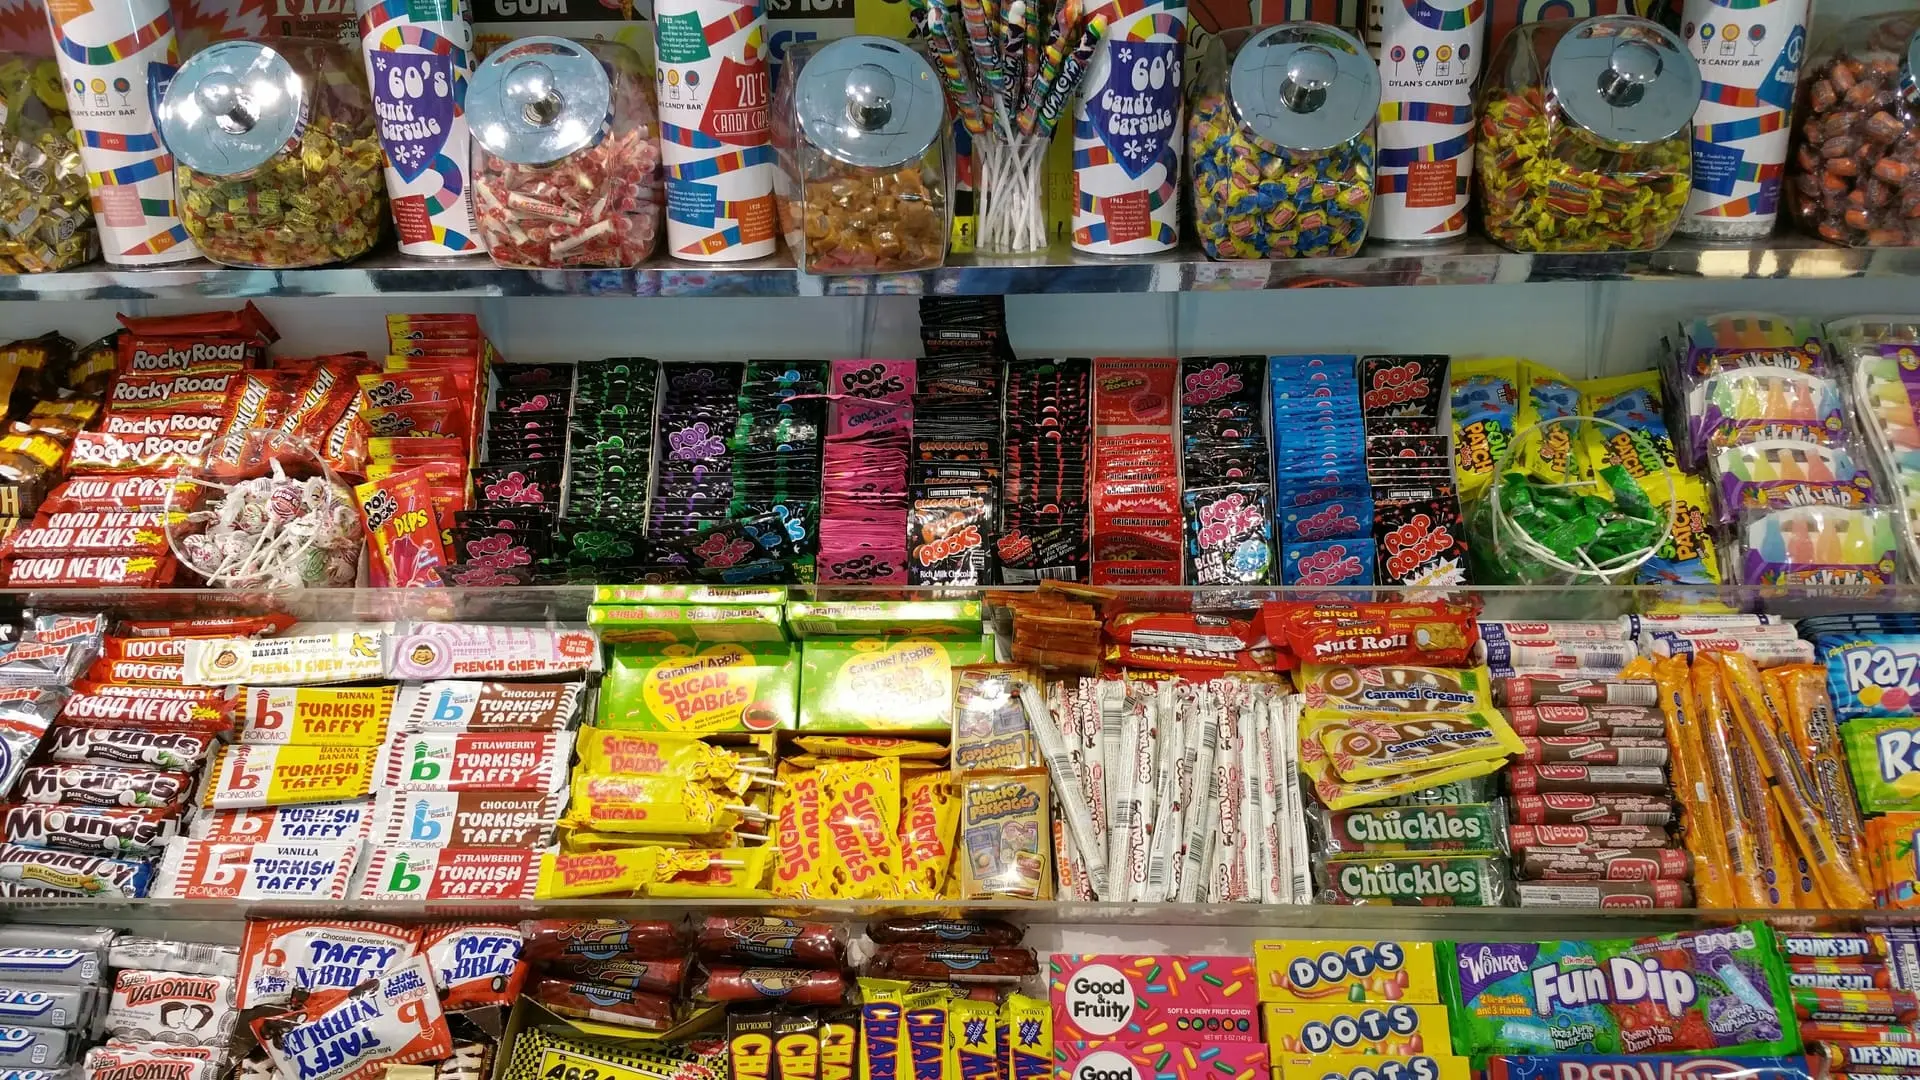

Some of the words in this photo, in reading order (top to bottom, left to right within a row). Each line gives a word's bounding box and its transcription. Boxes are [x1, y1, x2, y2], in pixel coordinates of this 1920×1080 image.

[1132, 50, 1180, 91] 60's
[389, 64, 448, 98] 60's
[374, 98, 413, 122] Candy
[1101, 88, 1153, 115] Candy
[90, 108, 118, 117] CANDY
[713, 111, 748, 132] CANDY
[1108, 108, 1172, 135] Capsule
[381, 118, 441, 141] Capsule
[133, 349, 191, 370] Rocky
[192, 342, 246, 361] Road
[842, 364, 886, 389] POP
[1185, 362, 1230, 392] POP
[1374, 362, 1422, 390] POP
[112, 378, 174, 400] Rocky
[174, 375, 229, 394] Road
[1365, 378, 1429, 410] ROCKS
[108, 414, 168, 435] Rocky
[74, 438, 142, 460] Rocky
[146, 436, 205, 457] Road
[1464, 421, 1494, 474] PATCH
[1611, 433, 1646, 479] PATCH
[1199, 493, 1244, 529] POP
[1296, 504, 1344, 536] POP
[392, 509, 428, 537] DIPS
[14, 528, 72, 548] GOOD
[74, 527, 138, 547] NEWS
[1384, 514, 1431, 555] POP
[920, 525, 982, 566] ROCKS
[1386, 526, 1454, 580] ROCKS
[67, 557, 128, 580] NEWS
[1194, 550, 1223, 570] BLUE
[1298, 545, 1347, 576] POP
[35, 619, 97, 643] Chunky
[1336, 626, 1382, 636] Salted
[126, 641, 156, 658] 100
[252, 648, 289, 658] BANANA
[1313, 639, 1357, 656] Nut
[1362, 635, 1407, 650] Roll
[114, 664, 145, 679] 100
[454, 659, 504, 673] FRENCH
[508, 659, 545, 672] CHEW
[549, 660, 593, 670] TAFFY
[656, 660, 704, 680] Caramel
[707, 652, 744, 669] Apple
[658, 672, 729, 705] SUGAR
[1365, 690, 1420, 700] Caramel
[1424, 690, 1474, 703] Creams
[64, 694, 130, 722] GOOD
[133, 699, 193, 722] NEWS
[298, 703, 375, 718] TURKISH
[480, 699, 554, 711] TURKISH
[675, 687, 748, 722] BABIES
[1544, 707, 1584, 718] Necco
[303, 719, 366, 733] TAFFY
[481, 711, 544, 723] TAFFY
[50, 726, 201, 758] Mounds
[244, 731, 286, 740] BONOMO
[471, 741, 536, 750] STRAWBERRY
[603, 736, 659, 755] SUGAR
[1386, 738, 1439, 753] Caramel
[1442, 730, 1492, 744] Creams
[277, 763, 359, 777] TURKISH
[456, 753, 535, 767] TURKISH
[281, 777, 349, 790] TAFFY
[460, 768, 526, 782] TAFFY
[480, 800, 539, 809] CHOCOLATE
[971, 785, 1022, 806] Wacky
[1551, 795, 1591, 805] Necco
[279, 808, 360, 823] TURKISH
[458, 812, 538, 827] TURKISH
[4, 808, 157, 846] Mounds
[282, 824, 349, 836] TAFFY
[462, 828, 528, 843] TAFFY
[1543, 827, 1583, 841] Necco
[277, 847, 319, 856] VANILLA
[454, 854, 525, 863] STRAWBERRY
[253, 858, 335, 875] TURKISH
[438, 866, 521, 880] TURKISH
[555, 855, 617, 872] SUGAR
[256, 876, 324, 891] TAFFY
[564, 864, 626, 884] DADDY
[188, 884, 237, 897] BONOMO
[441, 881, 510, 896] TAFFY
[321, 933, 356, 945] Chocolate
[357, 937, 383, 946] Covered
[310, 940, 396, 968] TAFFY
[1295, 942, 1397, 986] DOTS
[1460, 947, 1528, 984] WONKA
[384, 969, 420, 985] TAFFY
[1074, 977, 1125, 996] Good
[1534, 963, 1606, 1015] Fun
[1611, 957, 1692, 1016] Dip
[128, 981, 216, 1003] VALOMILK
[384, 978, 426, 998] TURKISH
[575, 985, 612, 997] STRAWBERRY
[613, 992, 631, 1000] ROLLS
[1097, 994, 1106, 1004] &
[1073, 1002, 1130, 1022] Fruity
[1477, 1008, 1491, 1016] and
[1499, 1006, 1532, 1016] flavors
[1756, 1010, 1775, 1023] Dip
[1308, 1008, 1412, 1049] DOTS
[1621, 1030, 1650, 1042] Cherry
[1652, 1026, 1671, 1036] Yum
[1658, 1034, 1673, 1044] Dip
[297, 1027, 381, 1079] TAFFY
[377, 1046, 392, 1054] Milk
[99, 1064, 193, 1080] VALOMILK
[1079, 1066, 1132, 1080] Good
